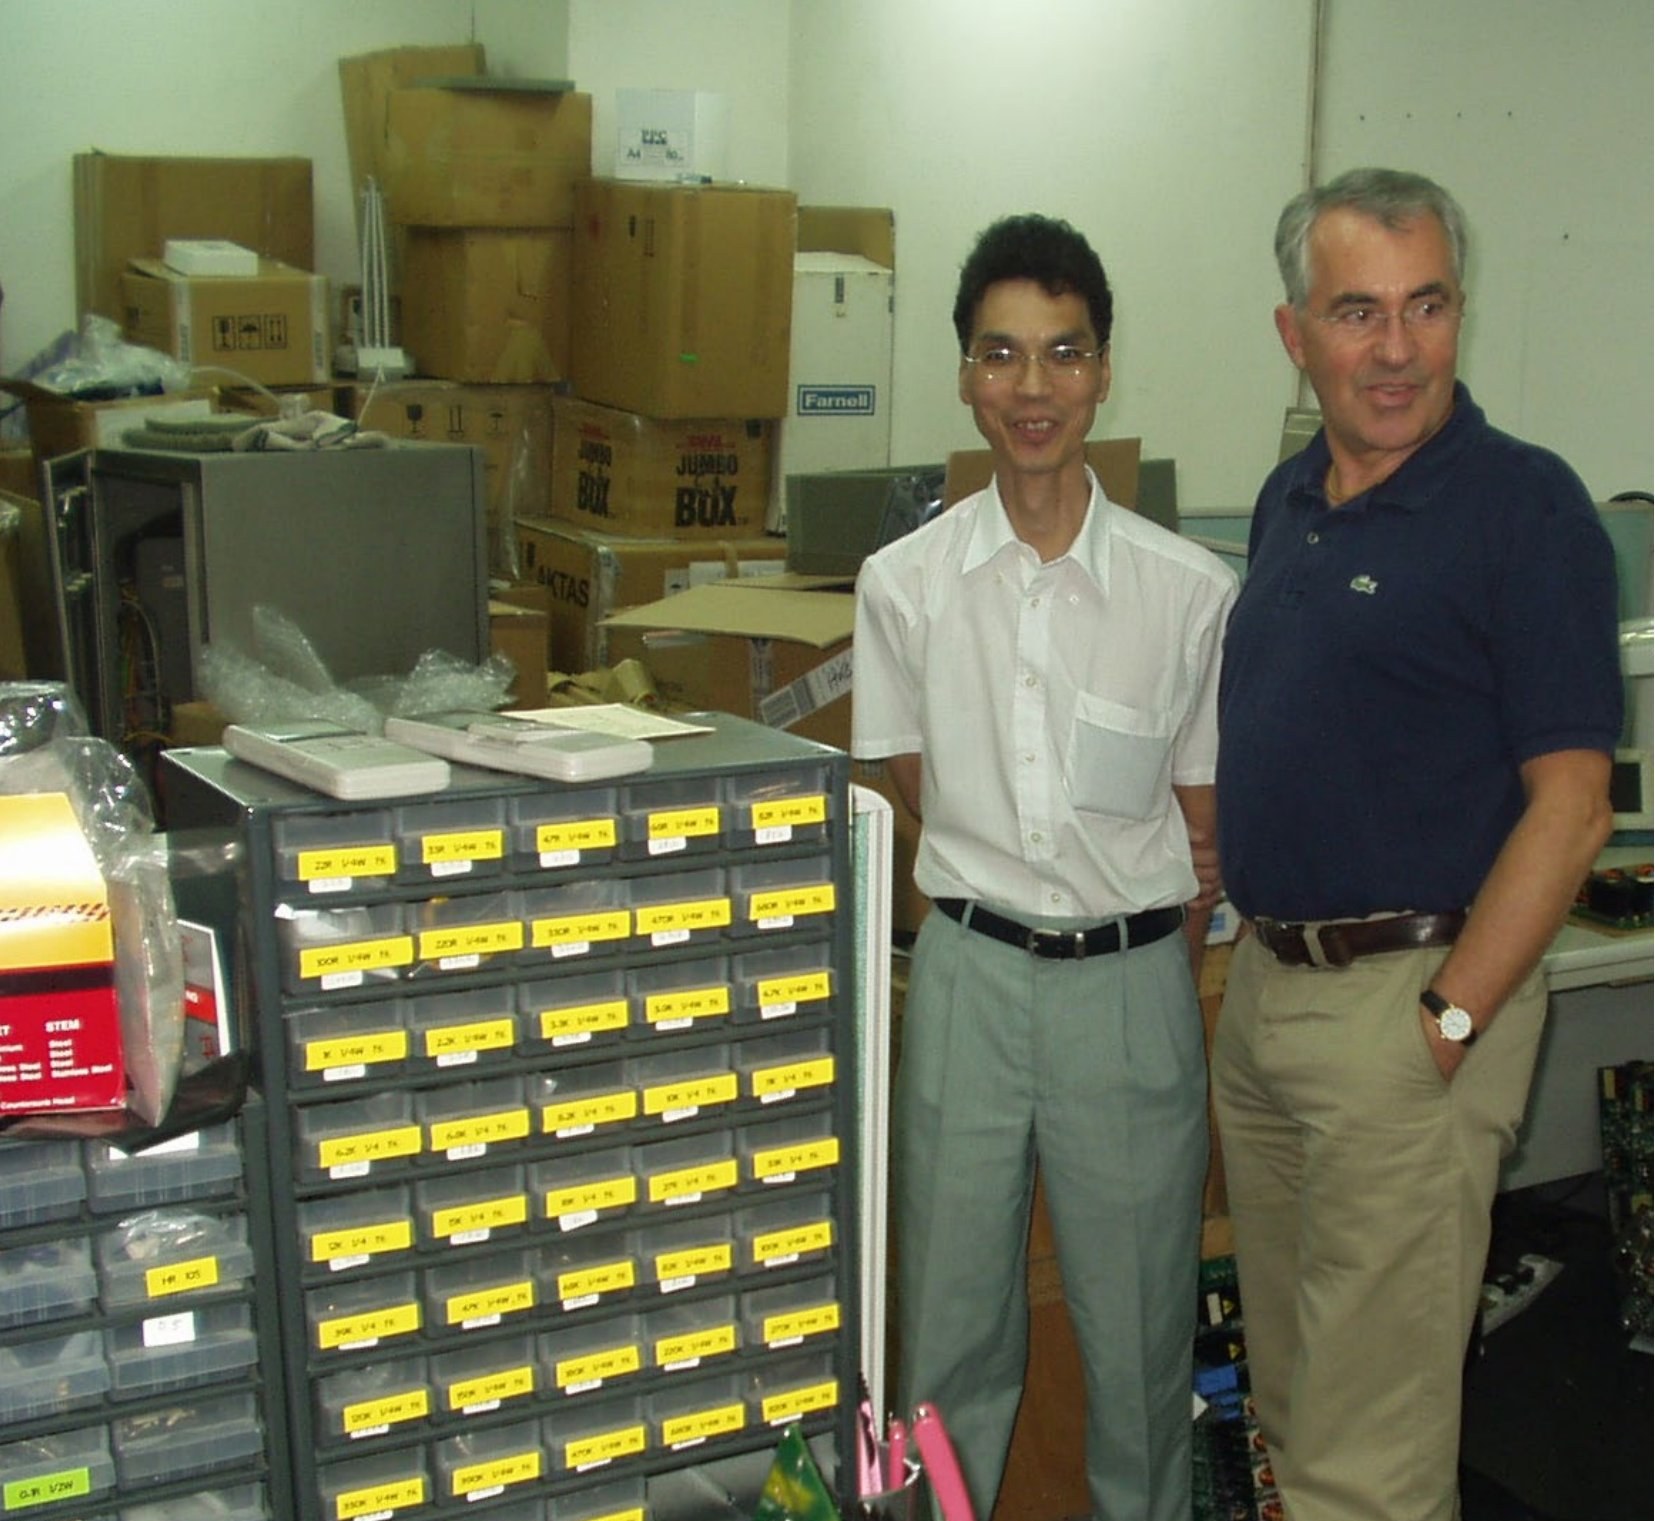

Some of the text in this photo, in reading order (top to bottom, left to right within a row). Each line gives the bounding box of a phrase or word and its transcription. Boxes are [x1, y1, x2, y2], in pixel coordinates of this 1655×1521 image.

[804, 393, 869, 408] Farnell
[676, 453, 738, 476] JUMBO
[675, 486, 737, 527] BOX
[45, 1018, 80, 1033] STEM
[48, 1039, 73, 1049] Steel
[49, 1048, 74, 1059] Steel
[50, 1058, 74, 1069] Steel
[91, 1063, 113, 1075] Steel
